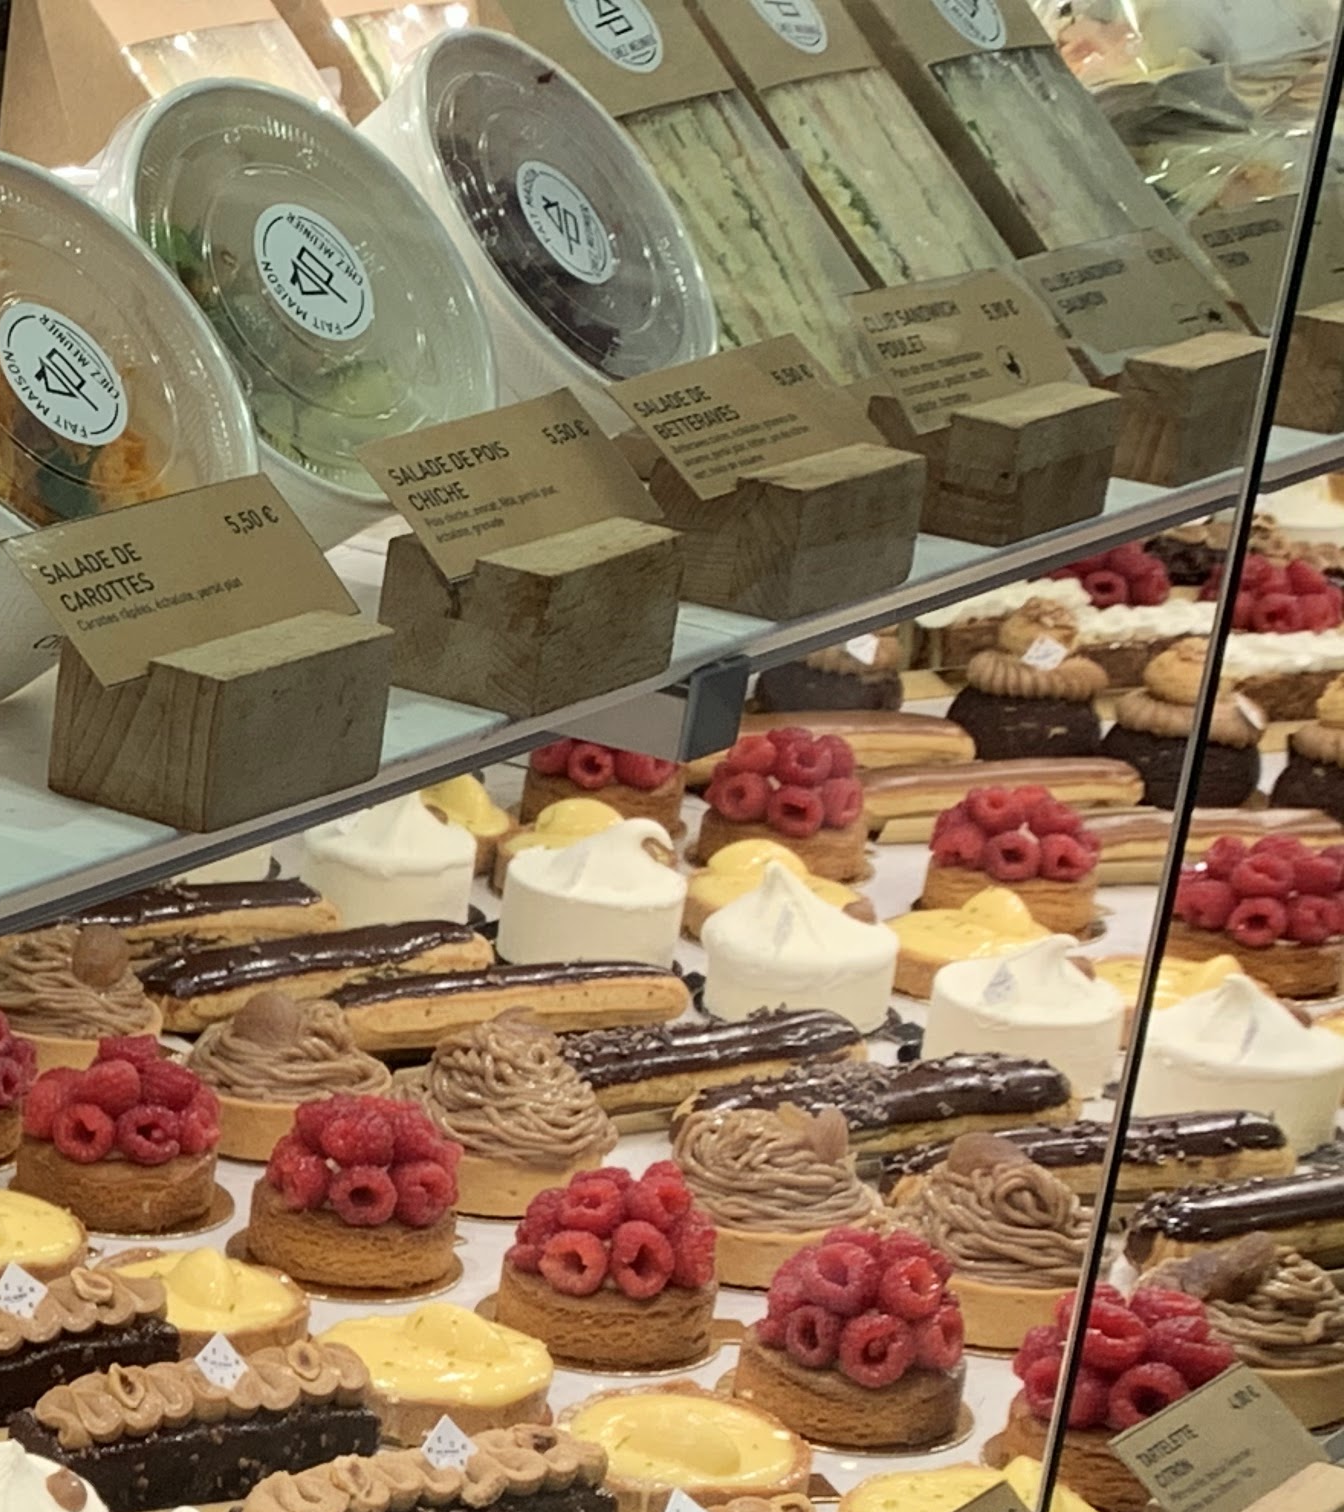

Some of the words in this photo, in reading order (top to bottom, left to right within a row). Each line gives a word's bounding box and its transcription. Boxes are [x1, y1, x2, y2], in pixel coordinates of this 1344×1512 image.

[285, 211, 335, 259] MEUNIER
[335, 259, 363, 286] CHEZ
[261, 260, 308, 321] MAISON
[38, 313, 91, 368] MEUNIER
[312, 316, 344, 335] FAIT
[2, 349, 51, 416] MAISON
[89, 369, 121, 400] CHEZ
[633, 389, 693, 418] SALADE
[692, 385, 712, 405] DE
[53, 414, 89, 439] FAIT
[540, 422, 576, 447] 5,50
[652, 403, 741, 440] BETTERAVES
[387, 454, 450, 487] SALADE
[448, 448, 476, 472] DE
[475, 440, 511, 464] POIS
[406, 480, 470, 512] CHICHE
[223, 509, 262, 536] 5,50
[262, 503, 280, 524] €
[39, 549, 112, 586] SALADE
[112, 541, 143, 566] DE
[58, 572, 155, 613] CAROTTES
